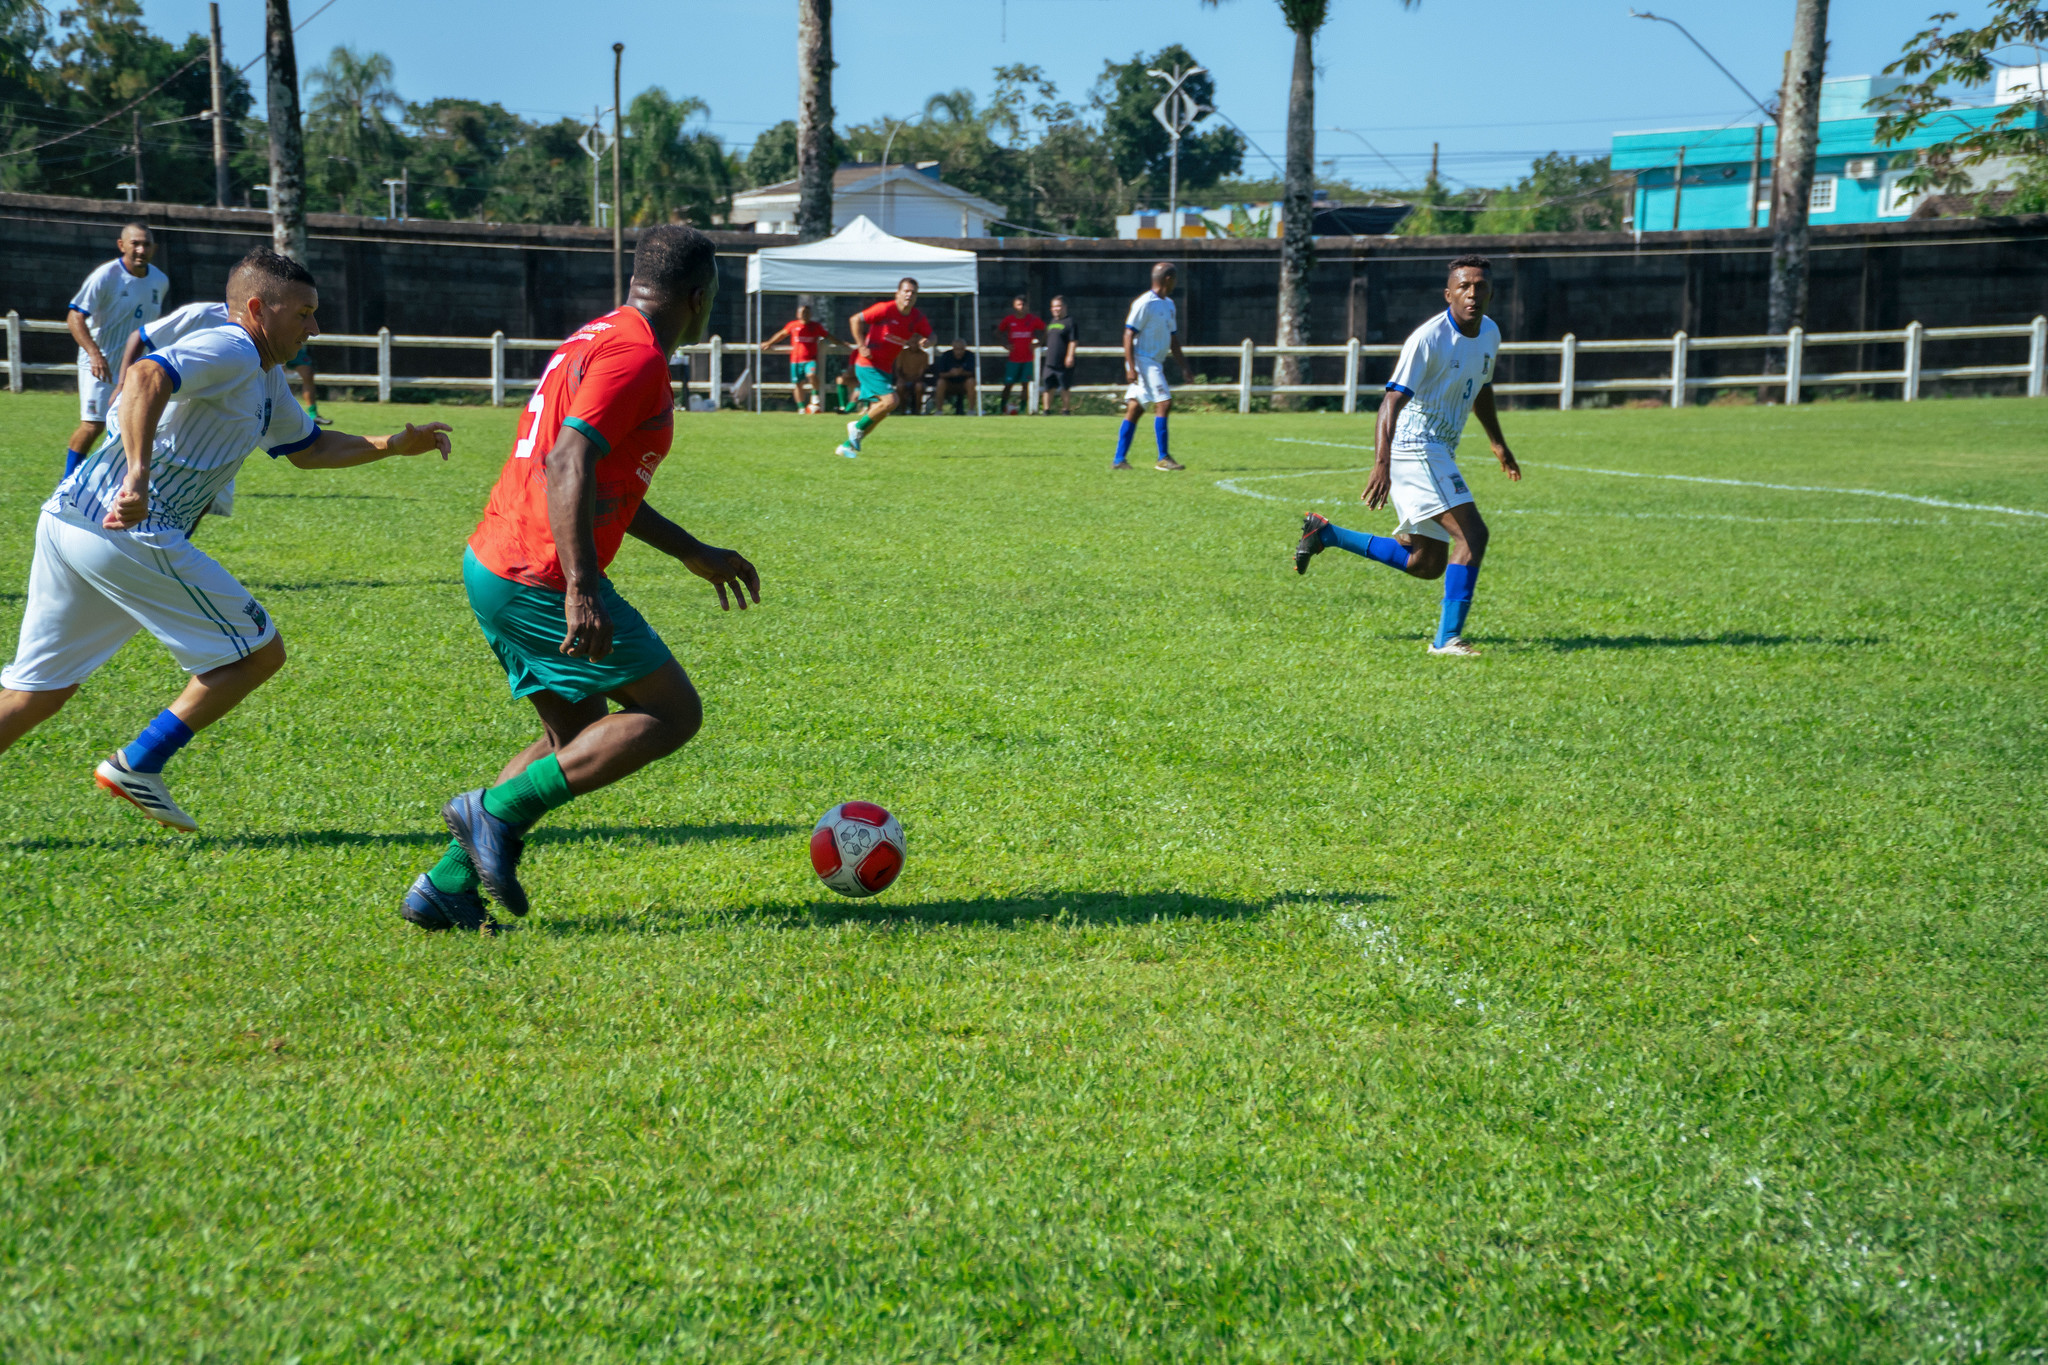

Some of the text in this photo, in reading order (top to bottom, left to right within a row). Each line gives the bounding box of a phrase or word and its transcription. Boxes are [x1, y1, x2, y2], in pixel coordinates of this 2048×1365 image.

[134, 303, 143, 319] 6
[1463, 378, 1473, 400] 3
[515, 353, 567, 458] 5
